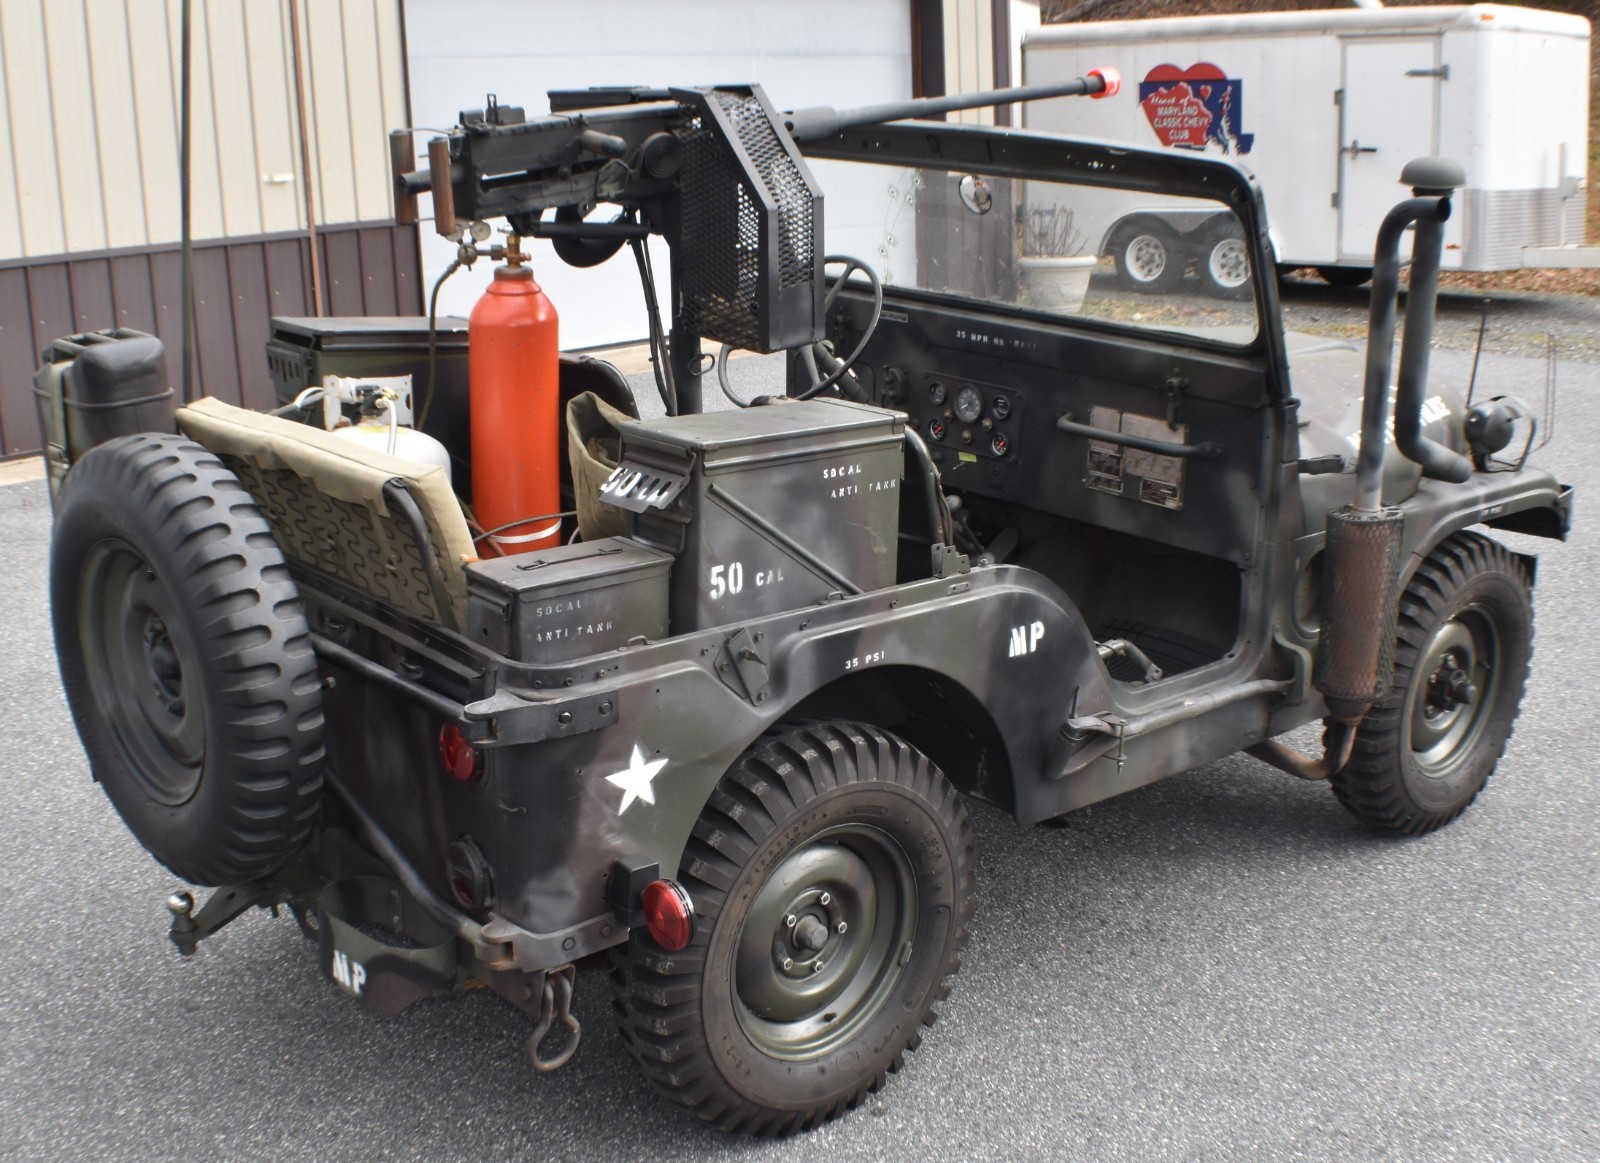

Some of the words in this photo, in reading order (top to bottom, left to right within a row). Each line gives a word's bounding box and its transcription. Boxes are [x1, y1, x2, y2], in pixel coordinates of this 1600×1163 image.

[1179, 96, 1190, 106] of
[1157, 105, 1198, 117] MARYLAND
[1154, 117, 1183, 128] CLASSIC
[1183, 116, 1209, 127] CHEVY
[1169, 129, 1190, 140] CLUB
[710, 562, 743, 600] 50
[756, 568, 784, 587] CAL
[1008, 621, 1045, 657] MP
[845, 657, 858, 669] 35
[865, 650, 885, 664] PSI
[333, 949, 367, 993] MP
